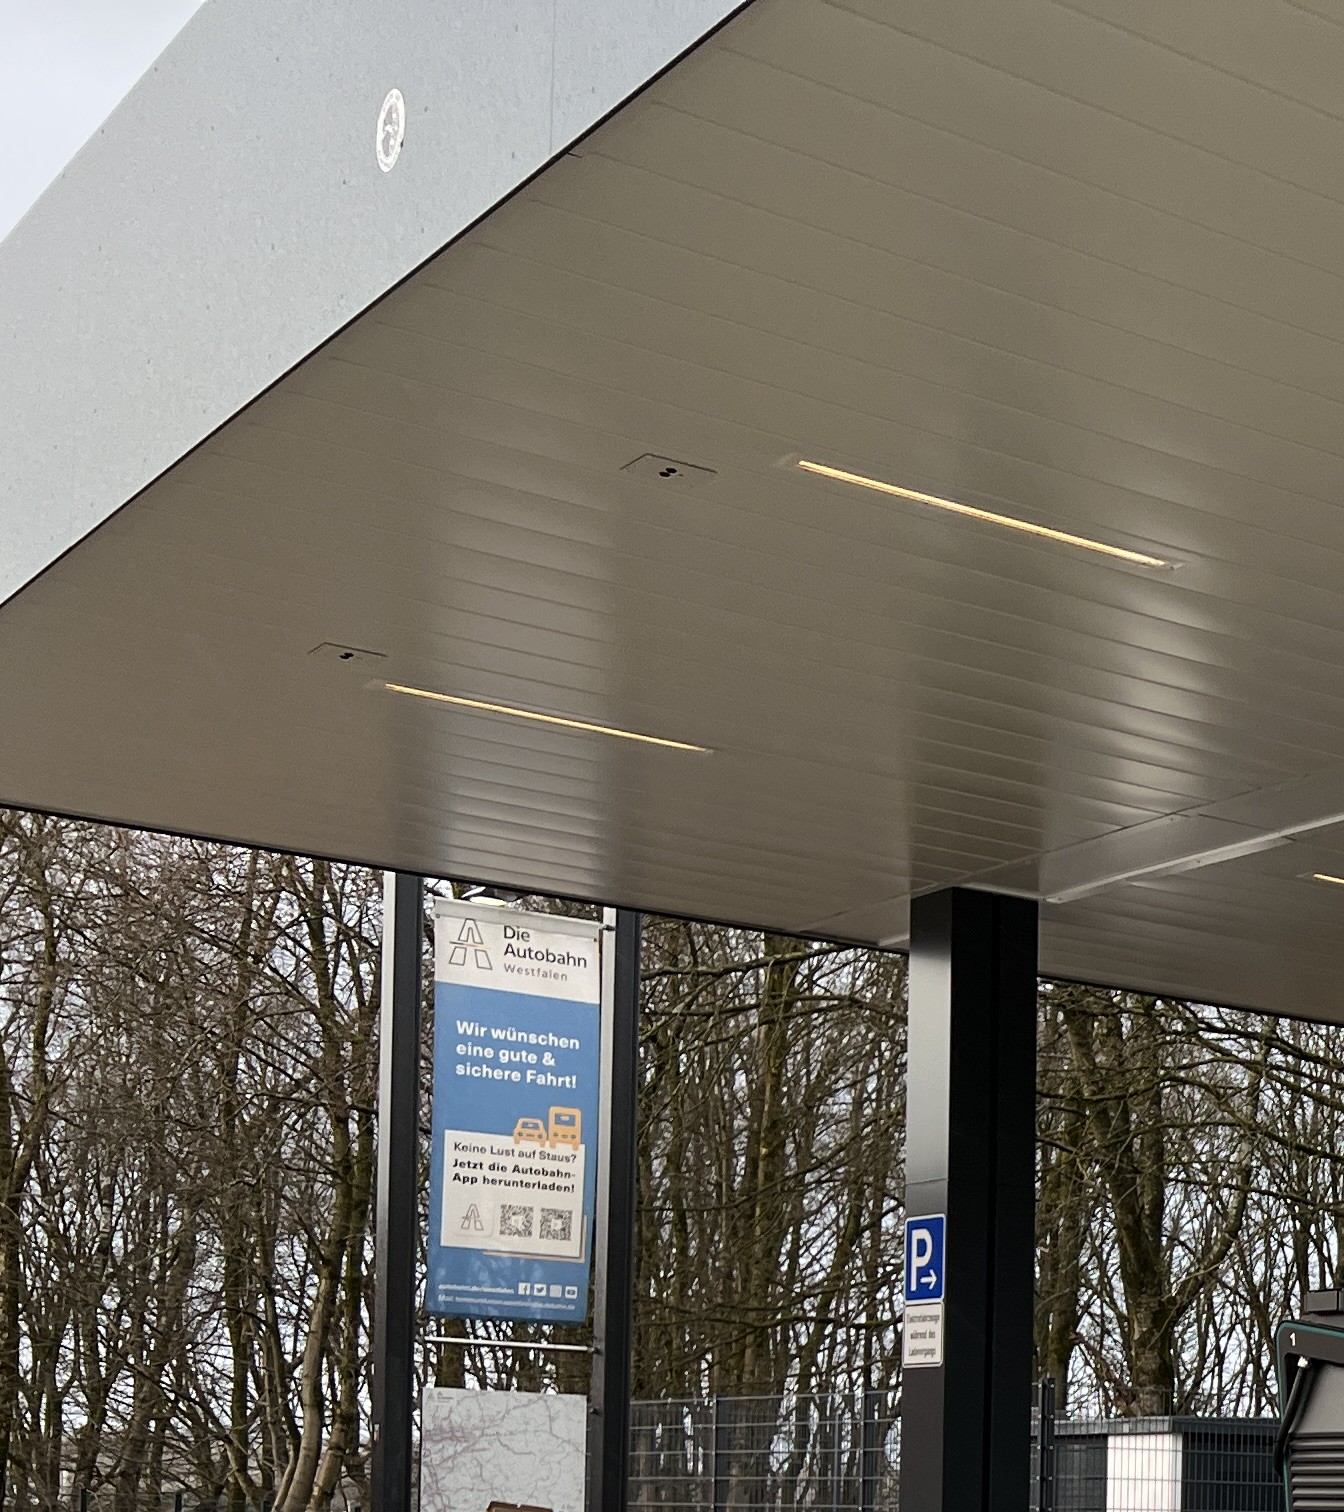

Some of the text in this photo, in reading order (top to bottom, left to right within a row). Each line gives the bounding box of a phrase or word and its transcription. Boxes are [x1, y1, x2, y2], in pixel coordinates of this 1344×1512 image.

[503, 925, 531, 942] Die
[503, 943, 588, 968] Autobahn
[504, 963, 568, 981] Westfalen
[456, 1020, 580, 1050] Wir wünschen
[456, 1042, 556, 1066] eine gute &
[455, 1062, 577, 1089] sichere Fahrt!
[453, 1142, 577, 1163] Keine Lust auf Staus?
[453, 1159, 576, 1179] Jetzt die Autobahn-
[453, 1173, 575, 1193] App herunterladen!
[910, 1228, 933, 1292] P
[1289, 1332, 1296, 1347] 1
